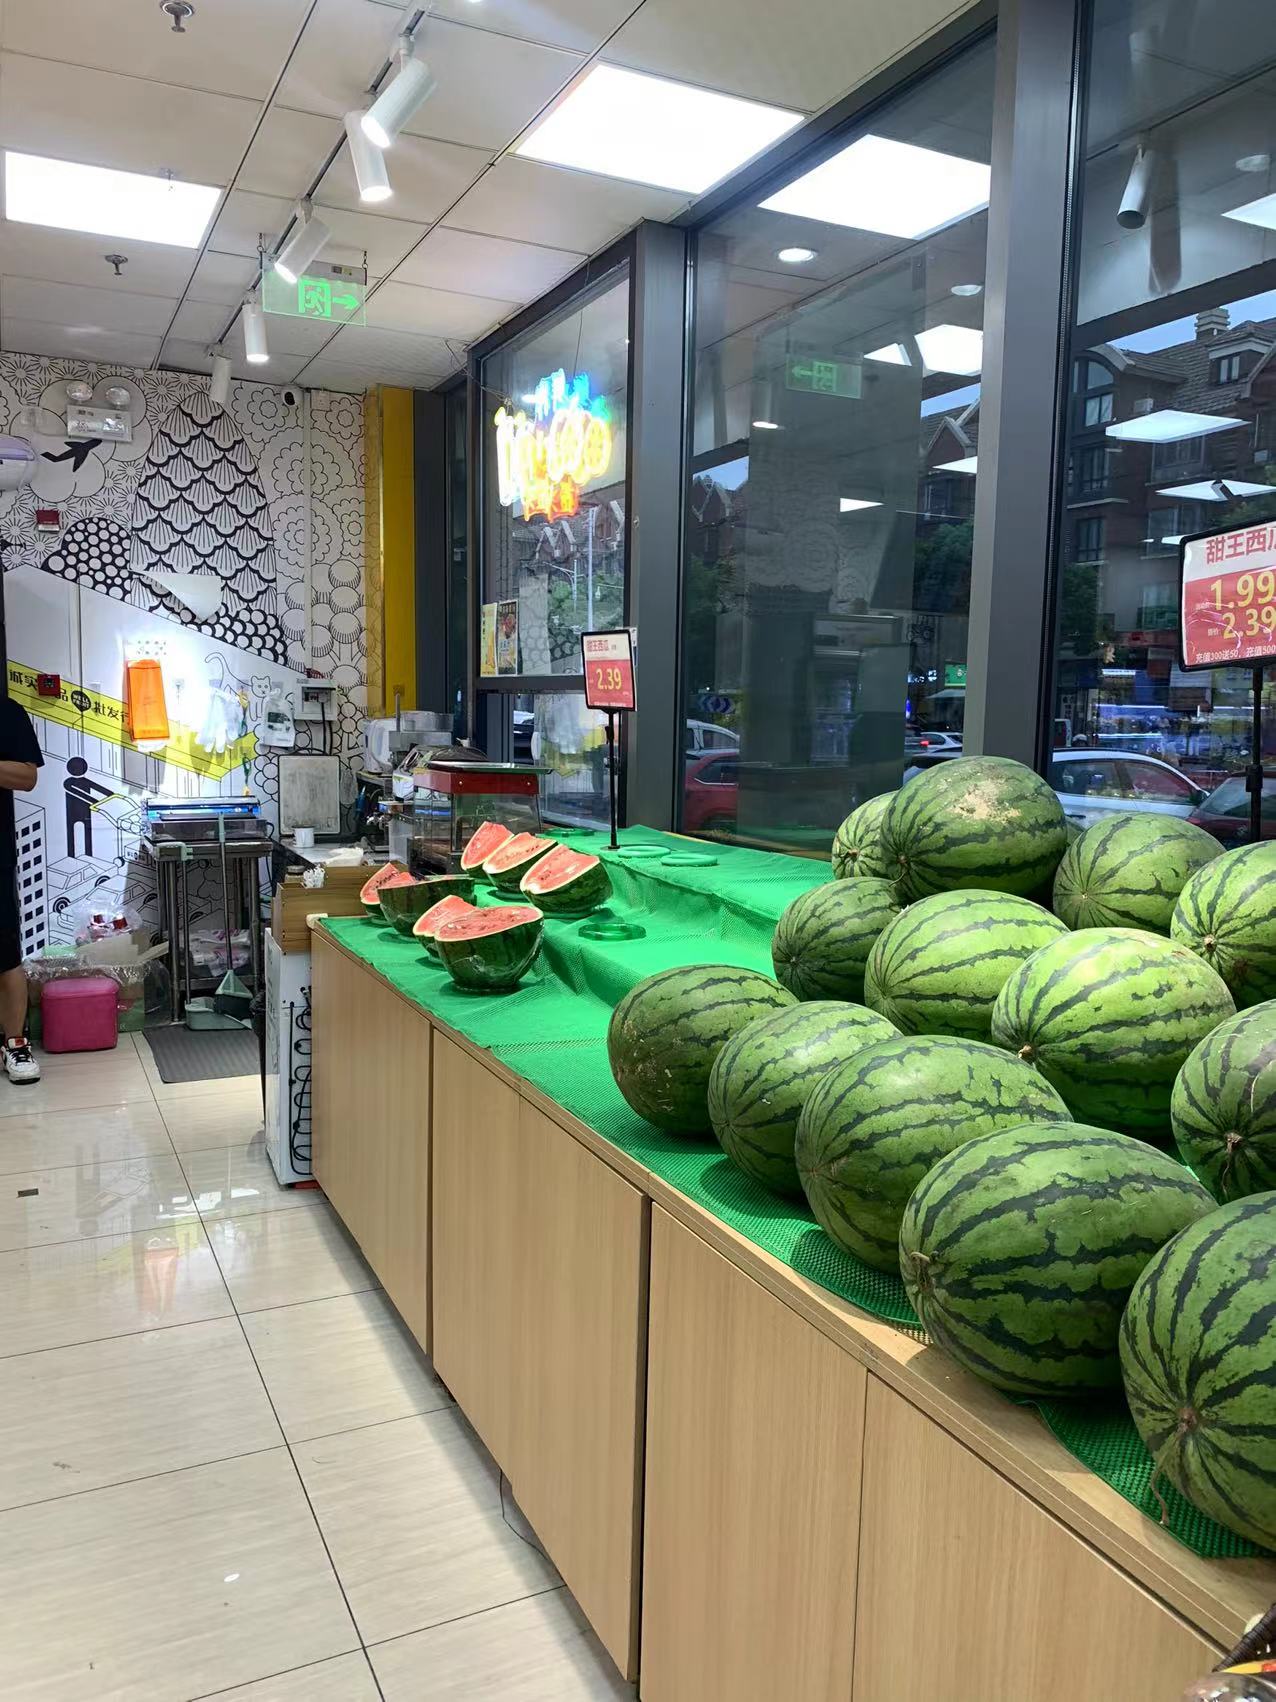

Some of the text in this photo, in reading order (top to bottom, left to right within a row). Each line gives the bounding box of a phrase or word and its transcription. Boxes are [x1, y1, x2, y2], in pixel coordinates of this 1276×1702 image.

[1210, 570, 1276, 611] 1.99
[1222, 606, 1276, 640] 2.39
[10, 670, 69, 702] 诚实品
[596, 668, 622, 690] 2.39
